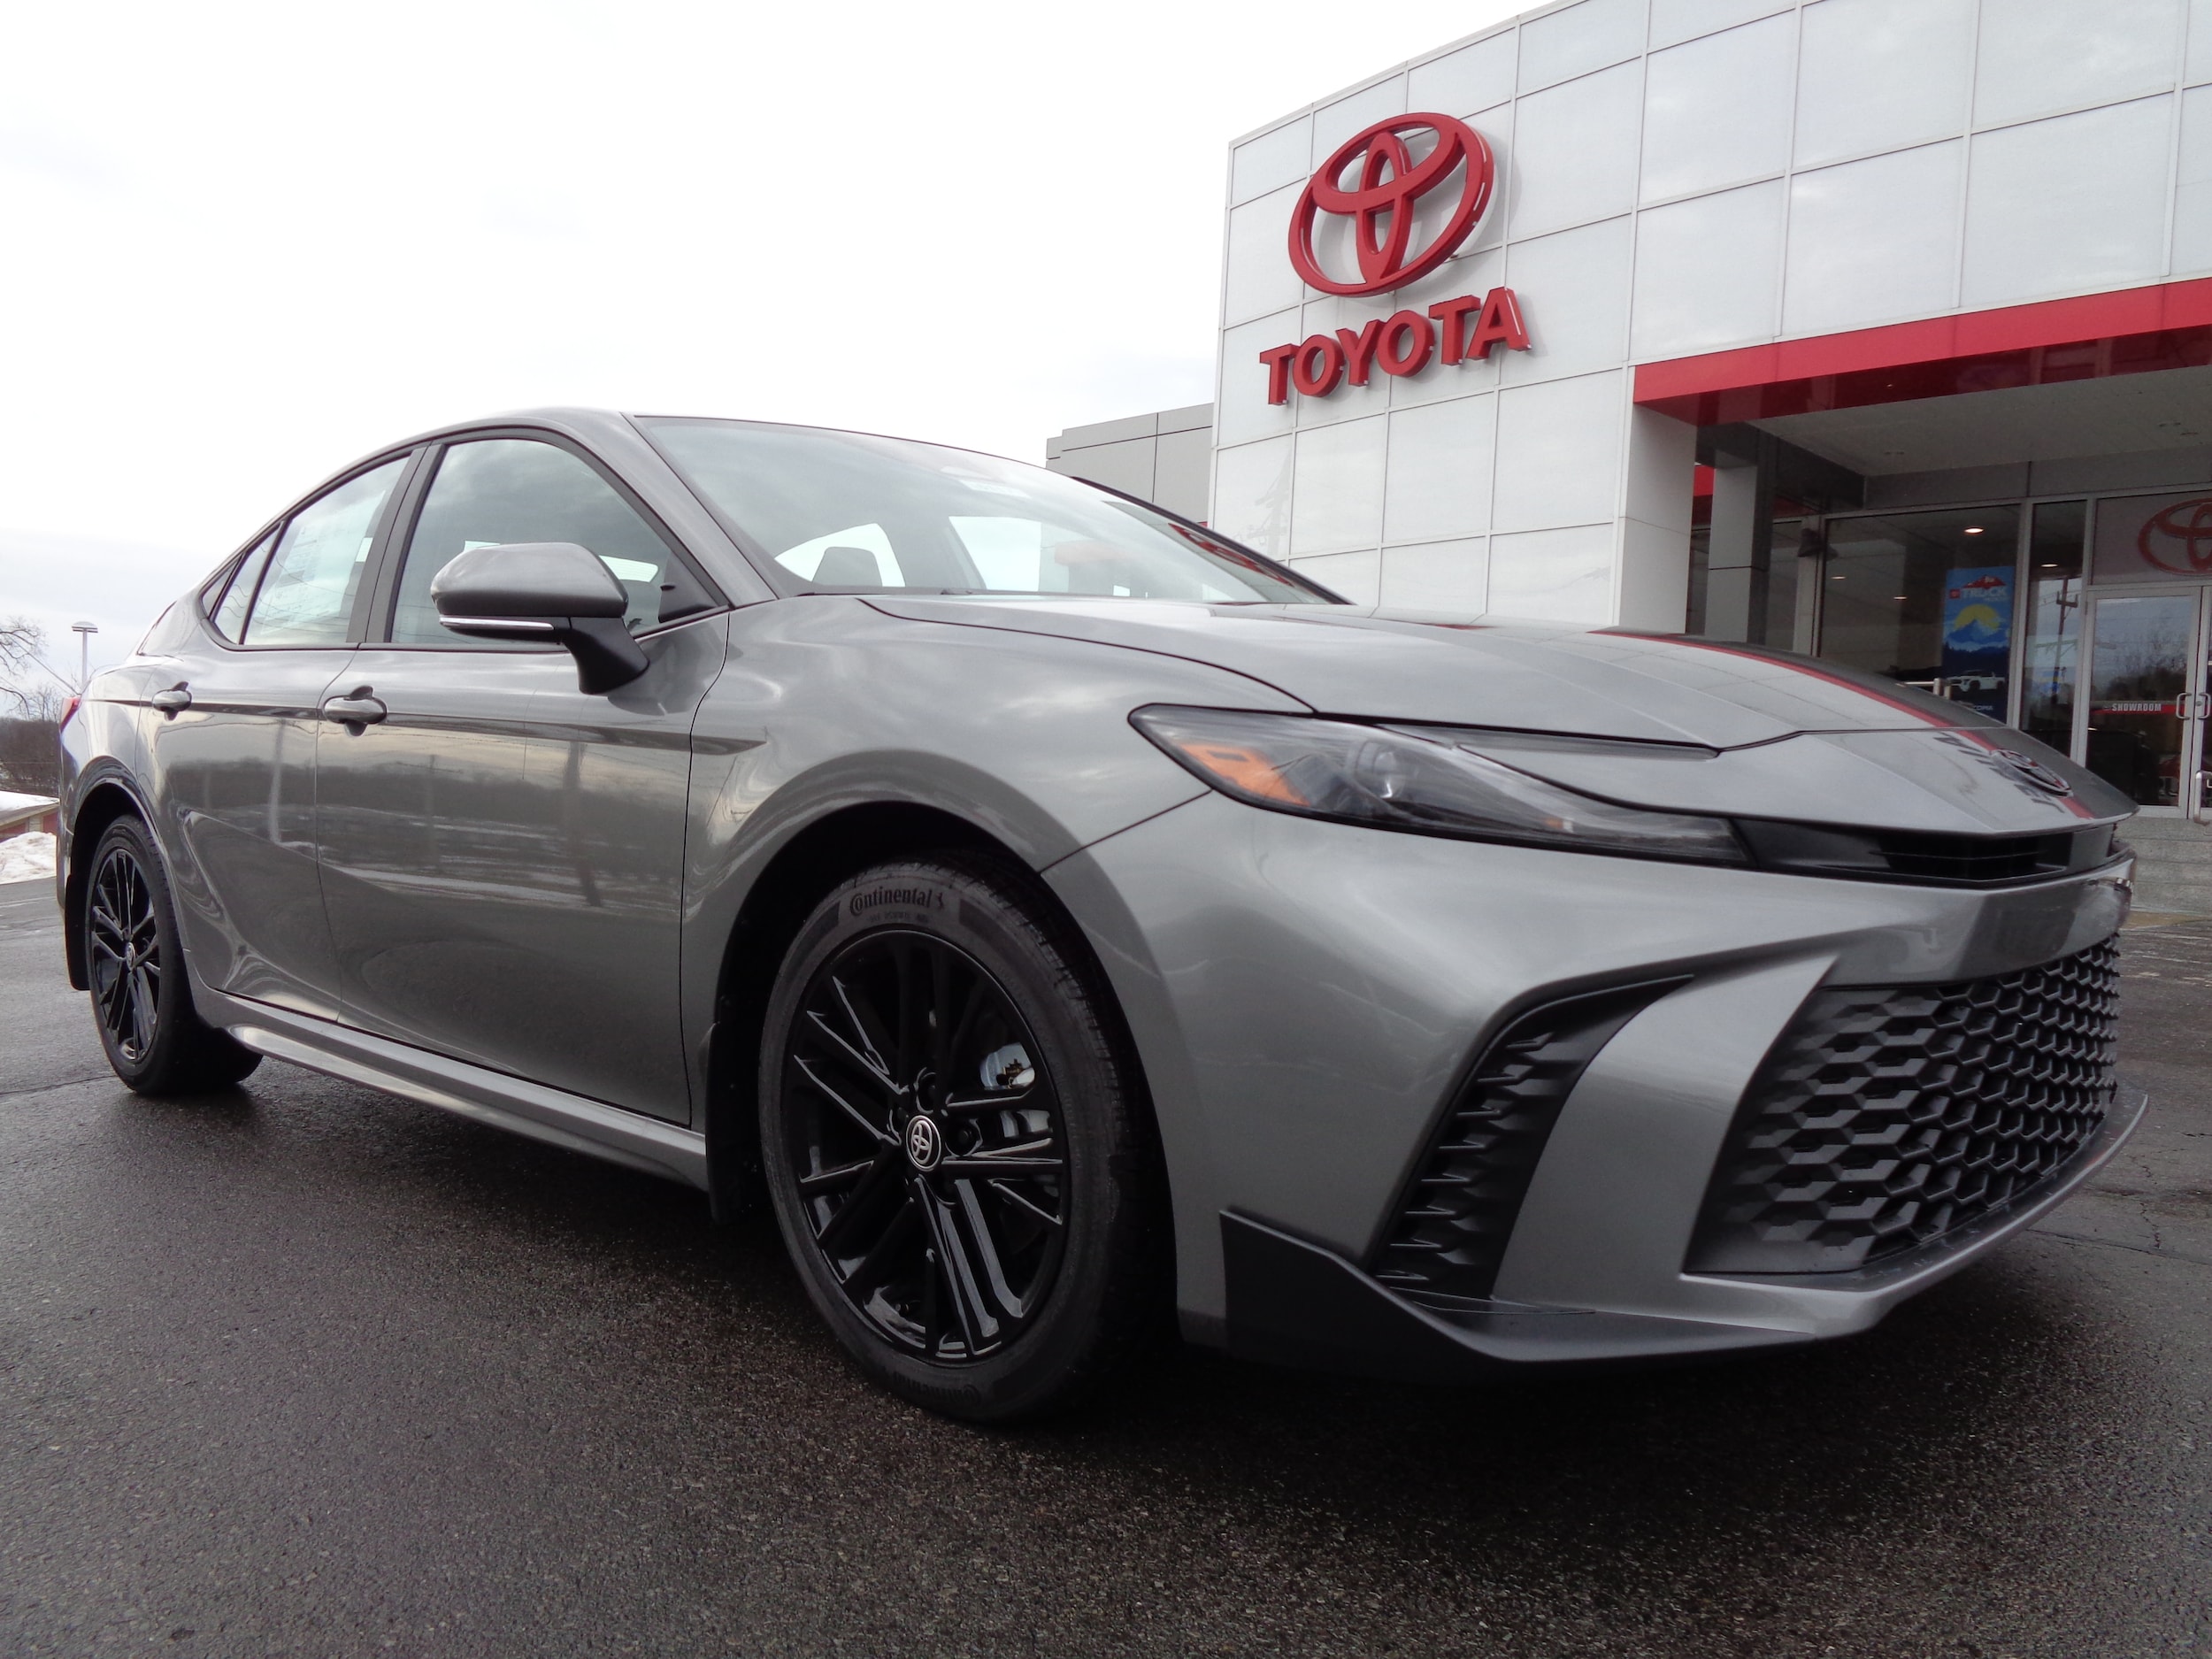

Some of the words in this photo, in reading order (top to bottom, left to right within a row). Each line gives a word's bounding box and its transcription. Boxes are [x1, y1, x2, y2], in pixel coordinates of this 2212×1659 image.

[1259, 287, 1532, 405] TOYOTA
[1961, 586, 2007, 598] TRUCK
[2111, 703, 2162, 711] SHOWROOM
[849, 887, 933, 916] Continental
